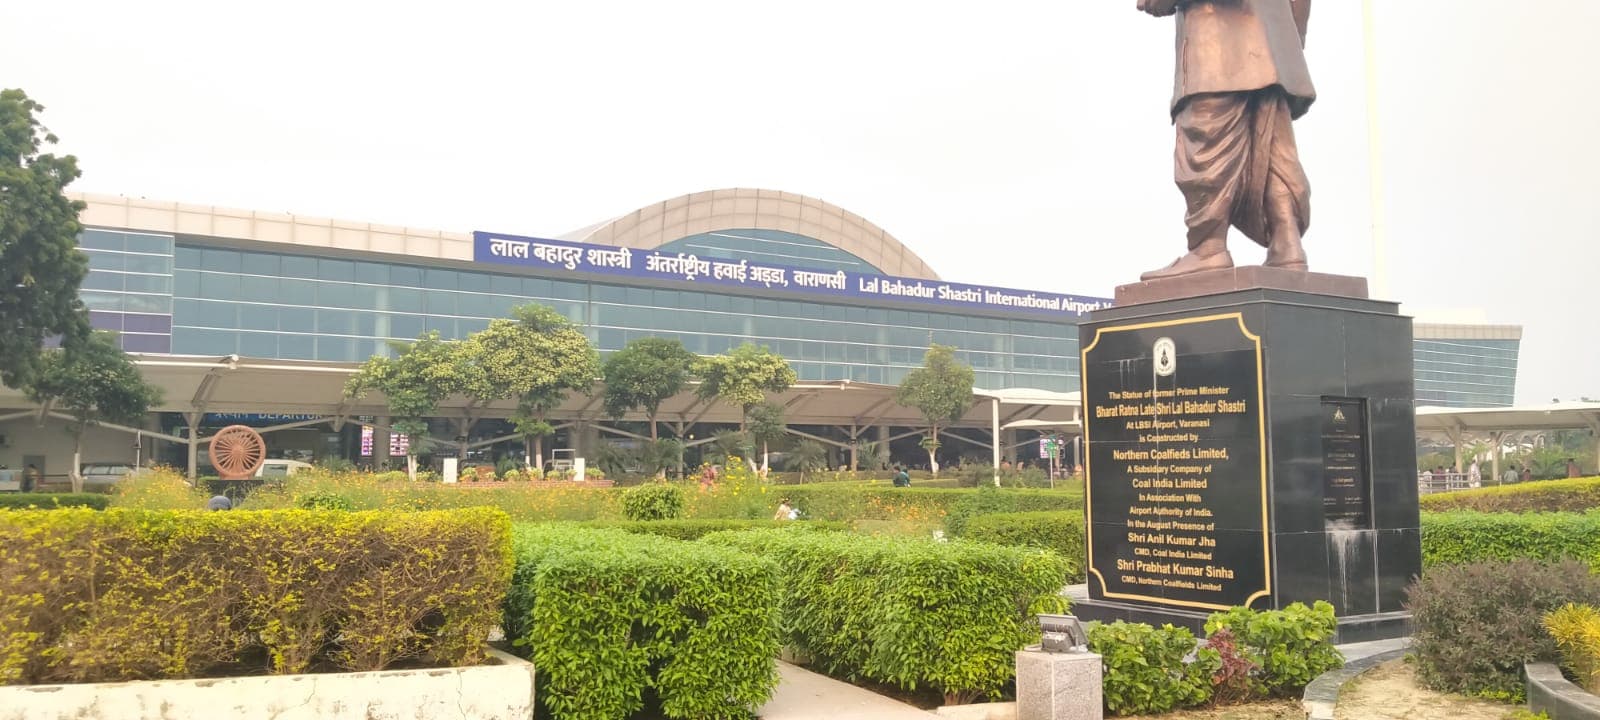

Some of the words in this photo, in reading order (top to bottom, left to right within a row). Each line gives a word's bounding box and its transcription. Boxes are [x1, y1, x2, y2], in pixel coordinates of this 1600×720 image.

[490, 238, 529, 258] लाल
[533, 242, 582, 270] बहादुर
[587, 247, 632, 269] शास्त्री
[646, 251, 710, 281] अंतर्राष्ट्रीय
[713, 260, 747, 283] हवाई
[794, 270, 846, 290] वाराणसी
[859, 277, 878, 294] Lal
[881, 279, 935, 299] Bahadur
[938, 283, 982, 303] Shastri
[985, 290, 1060, 310] International
[1061, 297, 1100, 316] Airport
[1109, 391, 1121, 400] The
[1122, 390, 1143, 399] Statue
[1144, 389, 1152, 398] of
[1177, 387, 1198, 396] Prime
[1199, 385, 1230, 396] Minister
[1096, 404, 1118, 418] Bharat
[1119, 403, 1139, 416] Ratna
[1140, 402, 1155, 416] Late
[1156, 401, 1171, 415] Shri
[1172, 401, 1183, 415] Lal
[1184, 400, 1217, 414] Bahadur
[1217, 399, 1246, 413] Shastri
[1126, 422, 1134, 430] At
[1135, 421, 1151, 430] LBSI
[1152, 420, 1178, 430] Airport,
[1179, 418, 1210, 428] Varanasi
[1139, 435, 1146, 443] is
[1147, 434, 1188, 443] Constructed
[1189, 433, 1199, 443] by
[1113, 449, 1149, 460] Northern
[1192, 447, 1229, 460] Limited,
[1127, 465, 1133, 473] A
[1133, 464, 1169, 474] Subsidiary
[1170, 464, 1203, 474] Company
[1204, 464, 1212, 473] of
[1132, 478, 1151, 489] Coal
[1152, 478, 1173, 489] India
[1175, 478, 1208, 489] Limited
[1139, 493, 1146, 502] In
[1146, 493, 1185, 503] Association
[1185, 493, 1202, 503] With
[1129, 506, 1152, 516] Airport
[1153, 506, 1183, 518] Authority
[1184, 508, 1193, 517] of
[1193, 508, 1213, 517] India.
[1127, 519, 1134, 528] In
[1135, 520, 1146, 529] the
[1147, 520, 1172, 531] August
[1172, 521, 1206, 531] Presence
[1206, 522, 1215, 531] of
[1128, 532, 1146, 543] Shri
[1147, 533, 1165, 544] Anil
[1166, 534, 1197, 546] Kumar
[1198, 536, 1216, 547] Jha
[1134, 547, 1152, 557] CMD,
[1152, 548, 1167, 557] Coal
[1168, 549, 1186, 558] India
[1186, 550, 1213, 561] Limited
[1117, 559, 1135, 571] Shri
[1136, 560, 1171, 574] Prabhat
[1172, 562, 1204, 577] Kumar
[1205, 565, 1234, 579] Sinha
[1121, 575, 1138, 585] CMD,
[1196, 581, 1222, 592] Limited
